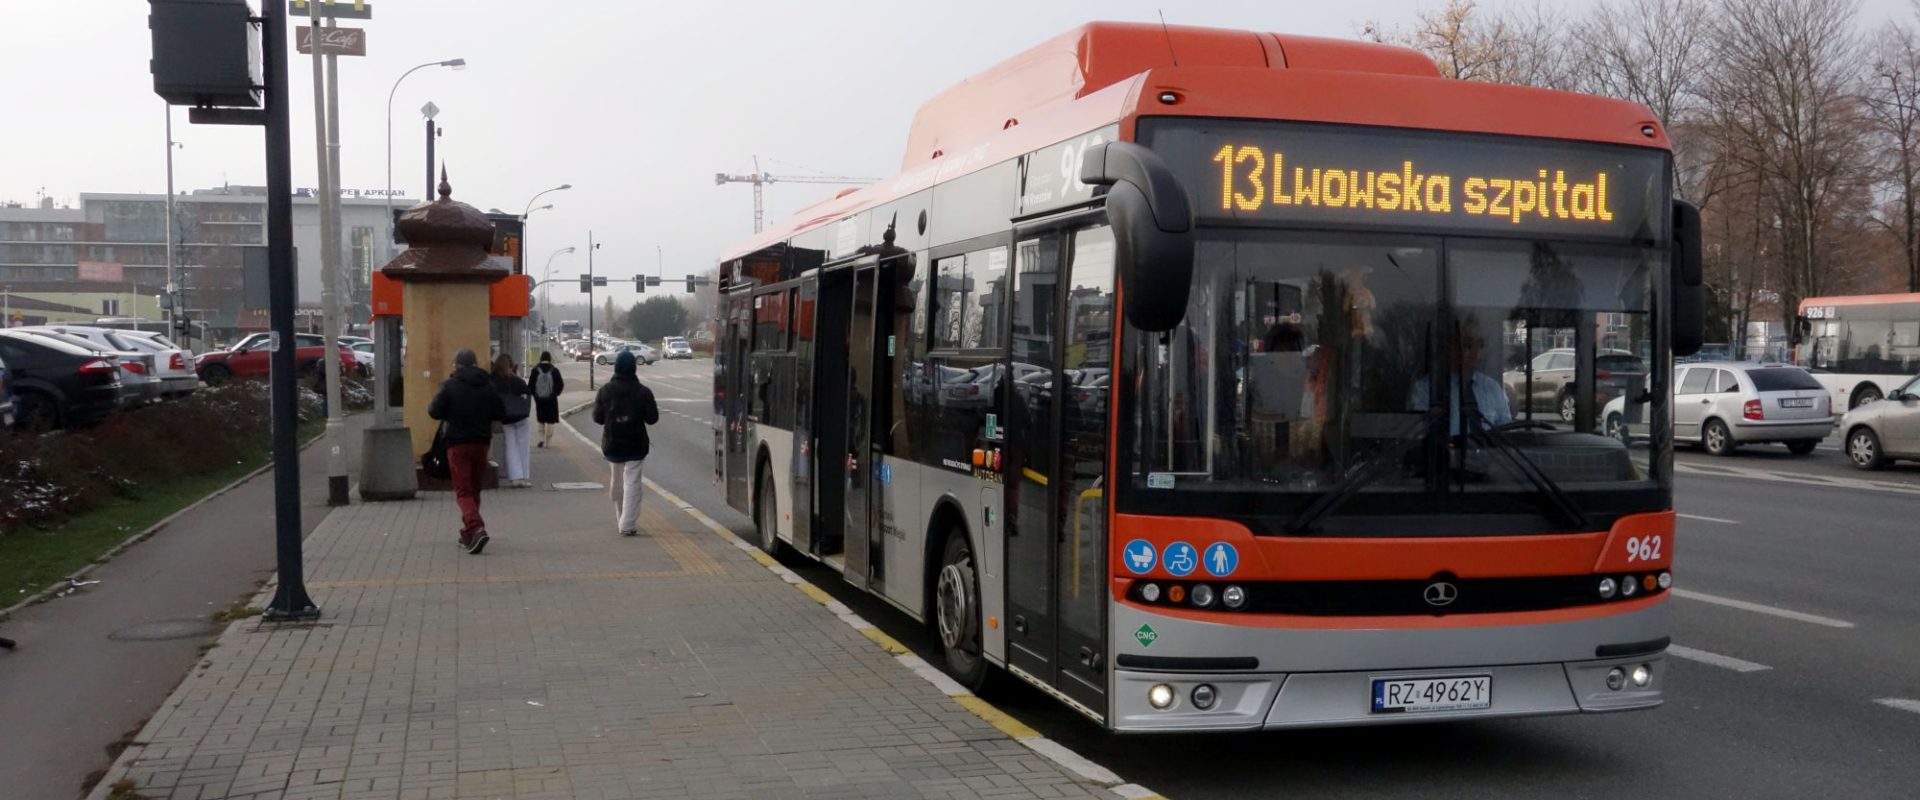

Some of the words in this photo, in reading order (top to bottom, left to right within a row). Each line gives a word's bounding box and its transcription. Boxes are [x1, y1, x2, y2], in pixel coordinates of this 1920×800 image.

[1213, 145, 1265, 210] 13
[1273, 153, 1451, 213] Lwowska
[1463, 169, 1612, 223] szpital
[1807, 306, 1823, 318] 926
[1626, 535, 1661, 563] 962
[1137, 631, 1155, 640] CNG
[1389, 683, 1415, 705] RZ
[1423, 680, 1484, 703] 4962Y
